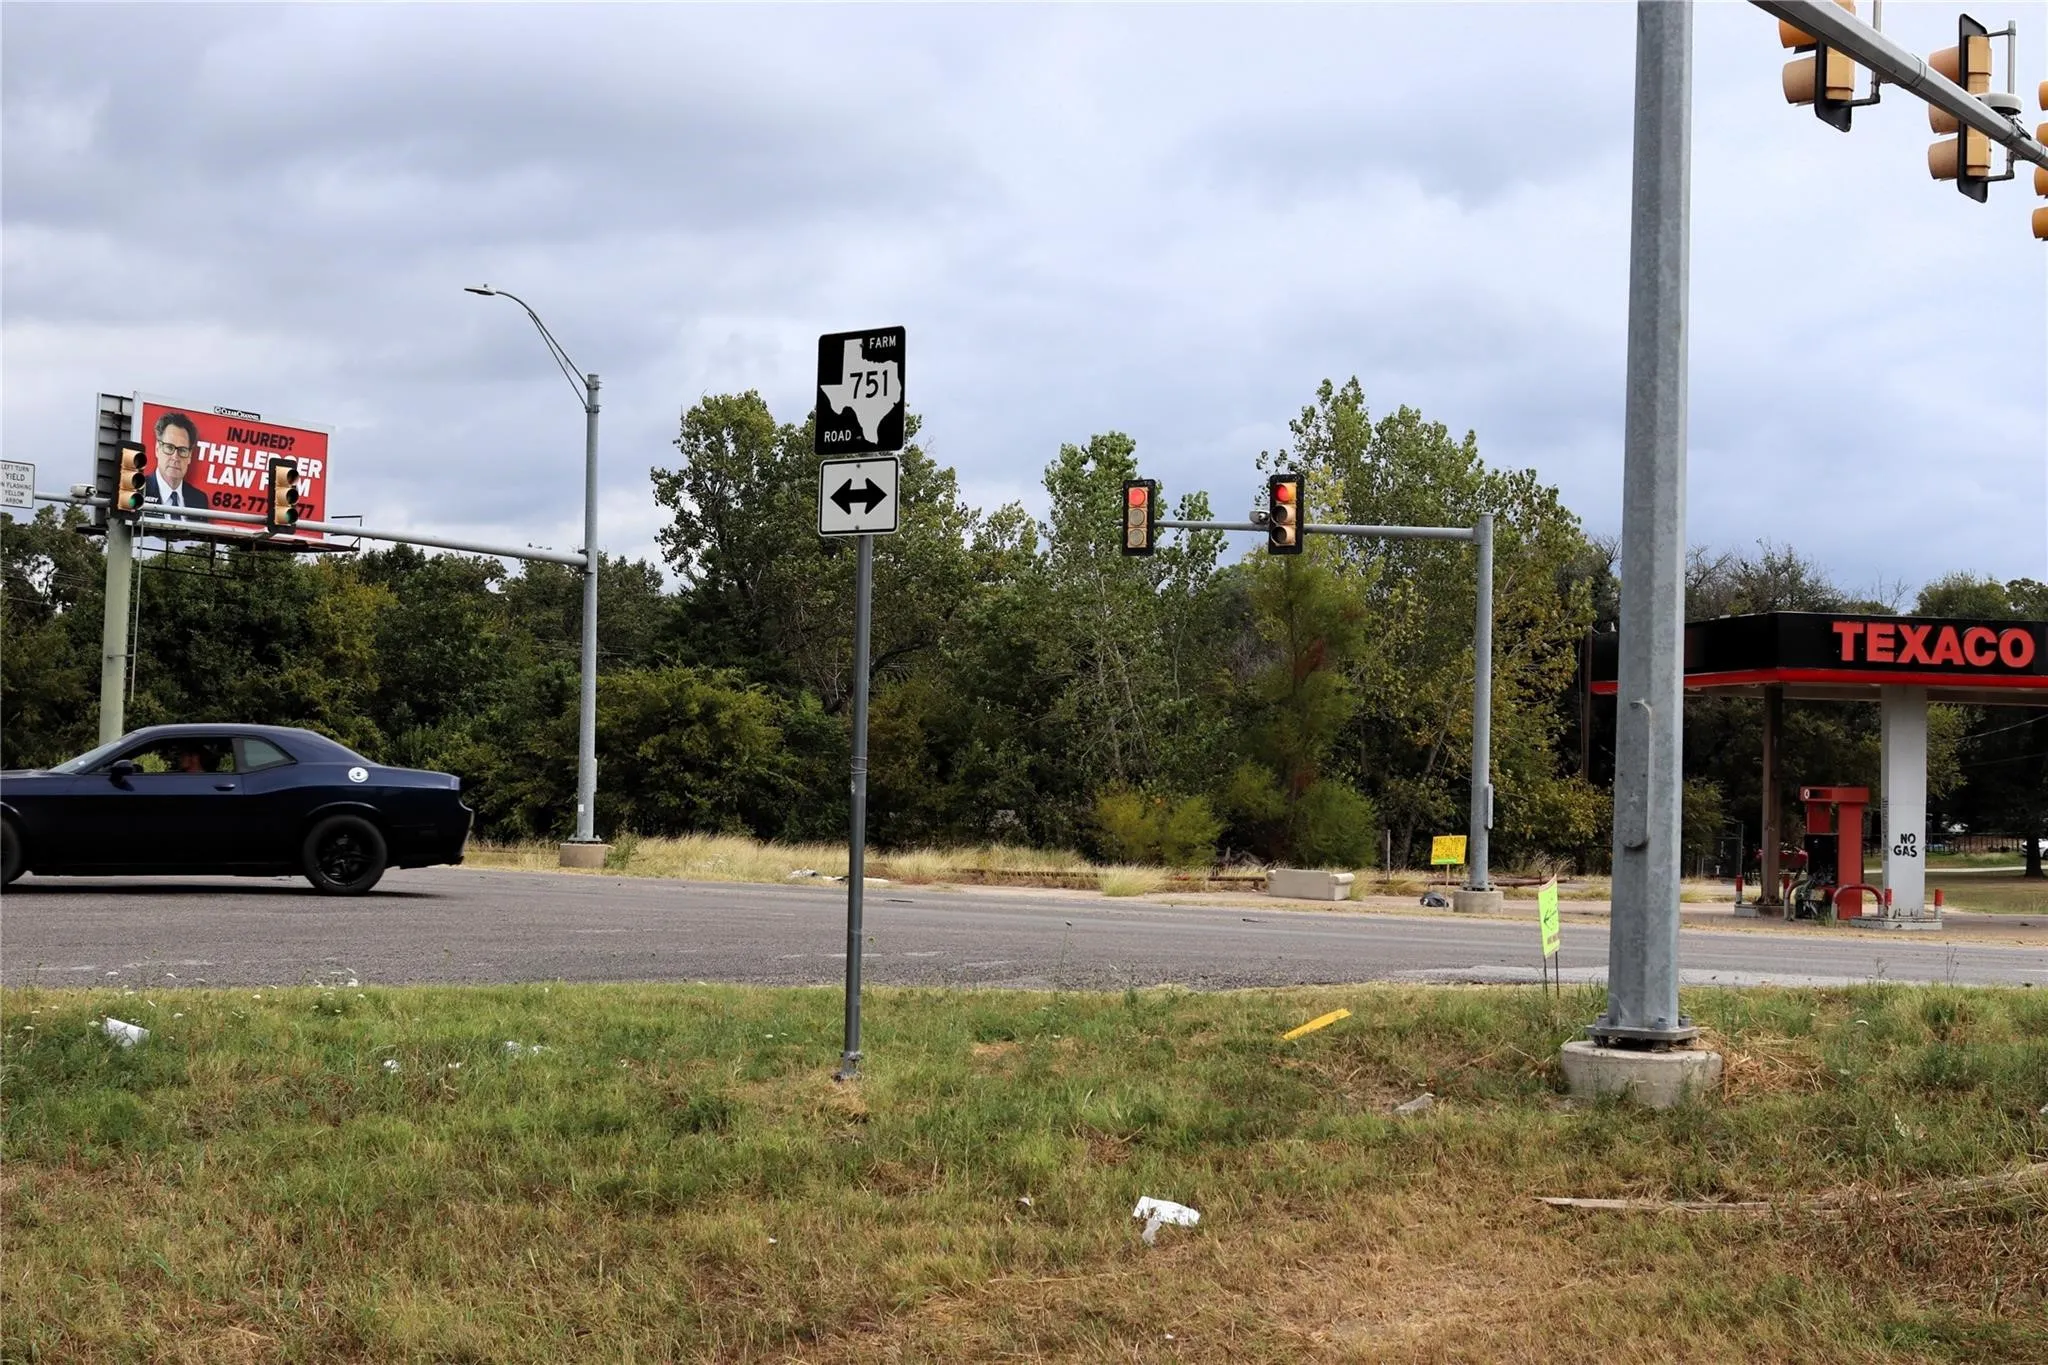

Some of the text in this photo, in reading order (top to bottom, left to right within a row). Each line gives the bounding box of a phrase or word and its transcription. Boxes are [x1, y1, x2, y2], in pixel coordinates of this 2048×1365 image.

[869, 335, 897, 349] FARM
[850, 369, 889, 399] 751
[227, 426, 295, 451] INJURED?
[824, 429, 852, 443] ROAD
[197, 441, 323, 478] THE LEER
[1, 463, 30, 473] LEFT TURN
[5, 472, 25, 482] YIELD
[207, 466, 312, 497] LAW FM
[1832, 620, 2036, 668] TEXACO
[1900, 833, 1916, 845] NO
[1893, 845, 1918, 858] GAS
